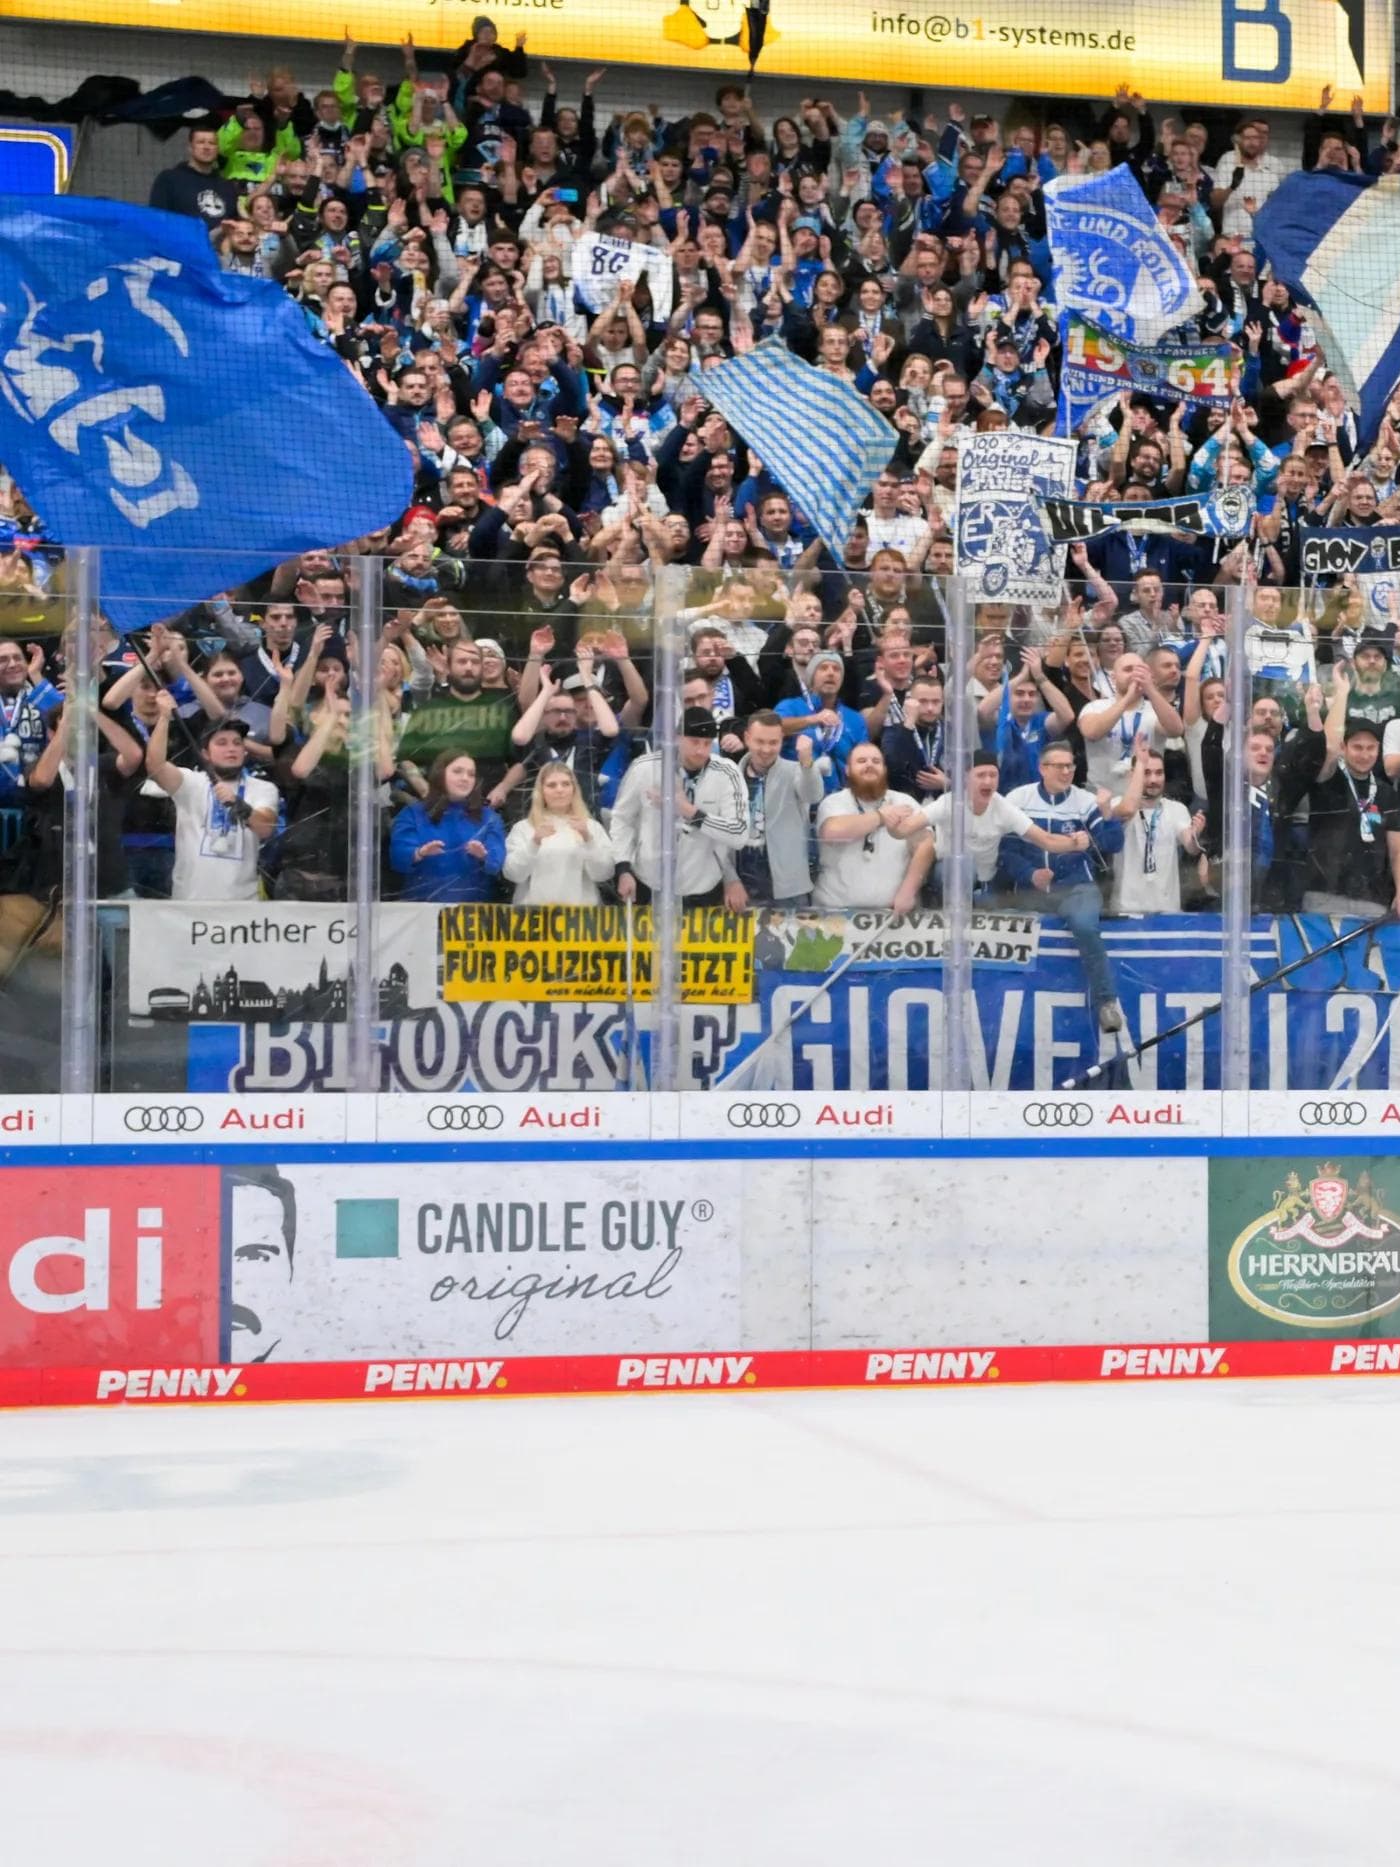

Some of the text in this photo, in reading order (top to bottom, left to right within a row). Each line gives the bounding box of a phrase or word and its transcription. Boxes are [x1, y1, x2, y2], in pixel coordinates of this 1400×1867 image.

[872, 11, 1136, 51] info@b1-systems.de
[962, 448, 1040, 470] Original
[191, 917, 316, 945] Panther
[852, 911, 1034, 933] GIOVAETTI
[852, 940, 1034, 963] INGOLADT
[445, 943, 497, 983] FÜR
[503, 950, 653, 983] POLIZISTEN
[673, 952, 738, 984] ETZT
[220, 1108, 304, 1131] Audi
[520, 1107, 601, 1129] Audi
[816, 1104, 894, 1127] Audi
[1107, 1103, 1183, 1125] Audi
[417, 1201, 587, 1254] CANDLE
[431, 1246, 684, 1340] original
